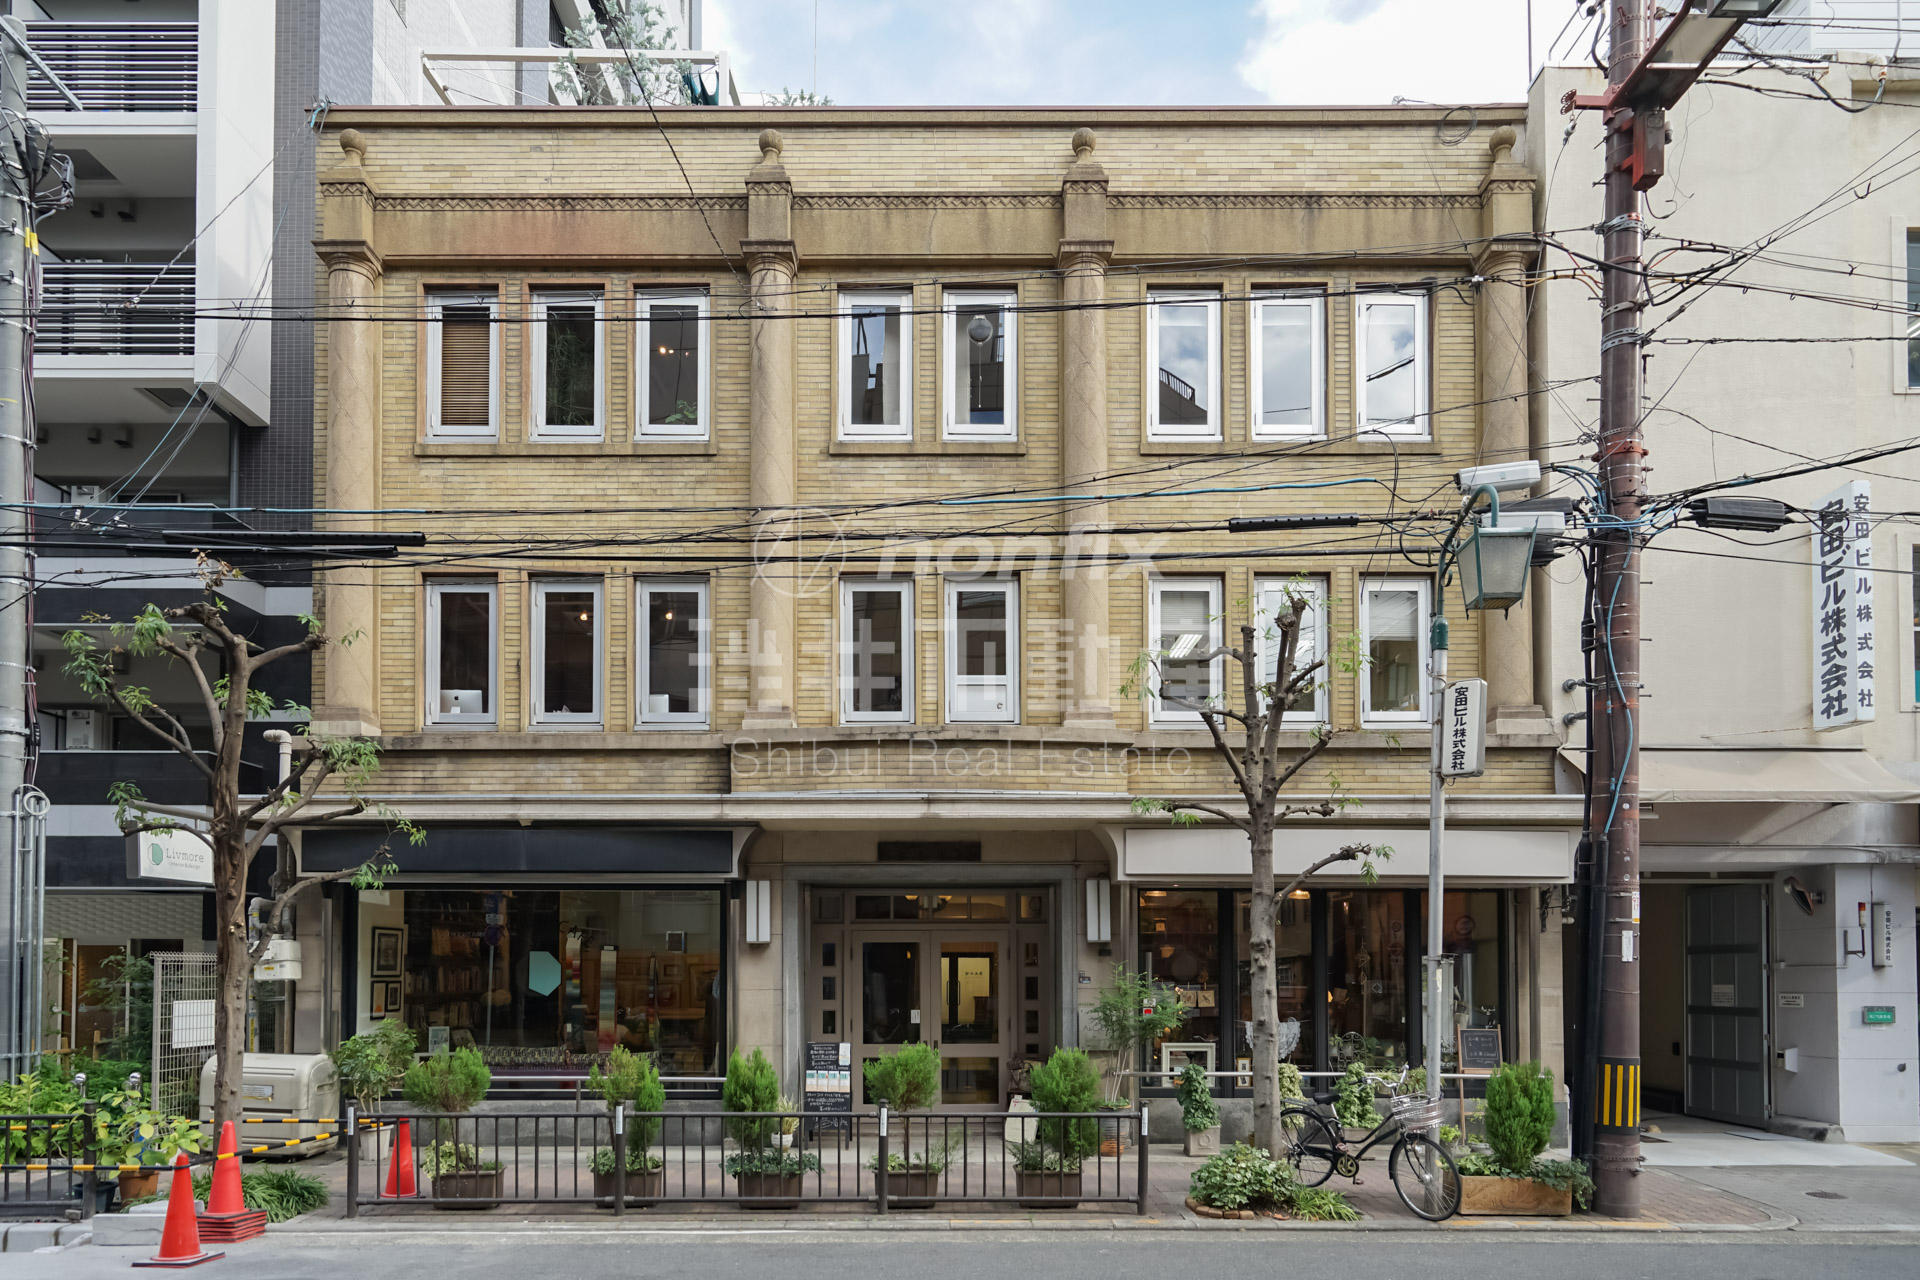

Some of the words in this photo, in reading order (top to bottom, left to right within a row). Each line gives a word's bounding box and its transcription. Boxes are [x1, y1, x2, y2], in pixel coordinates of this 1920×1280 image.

[1854, 493, 1873, 708] 安田ビル株式会社
[1451, 686, 1469, 771] 安田ビル株式会社
[166, 848, 204, 863] Livmore
